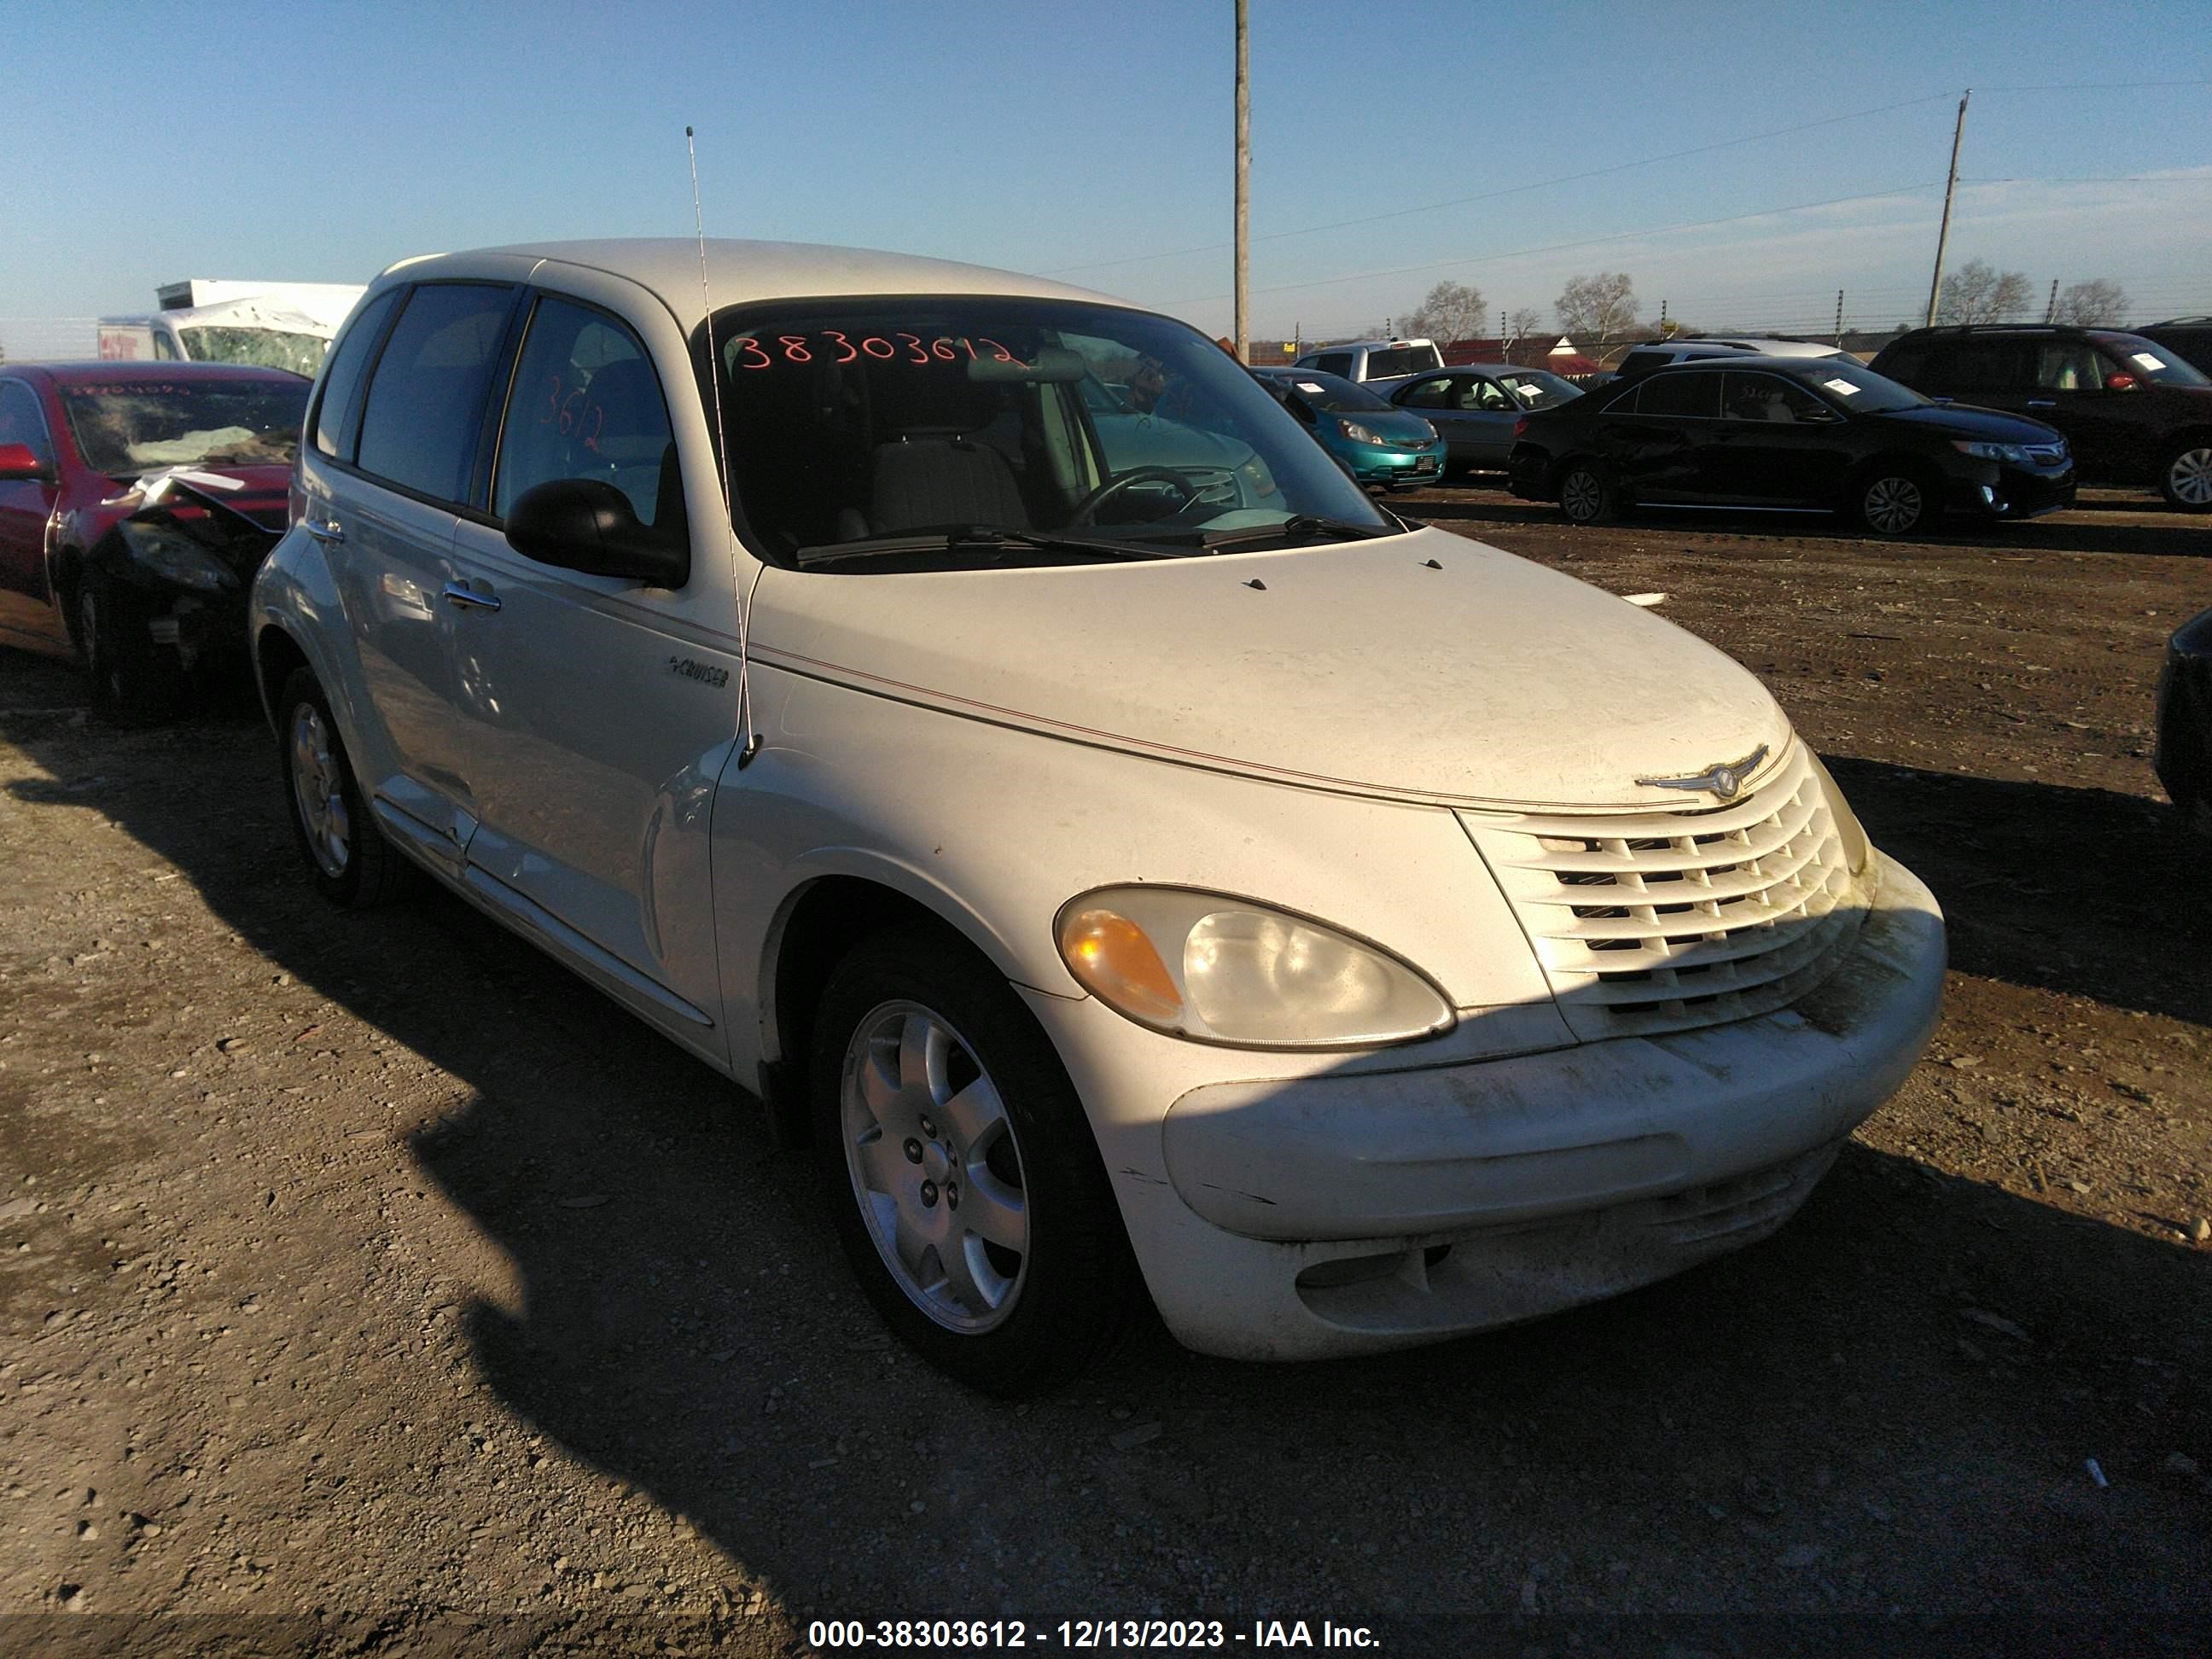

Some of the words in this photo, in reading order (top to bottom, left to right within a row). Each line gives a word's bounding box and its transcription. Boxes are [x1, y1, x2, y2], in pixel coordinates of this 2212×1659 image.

[736, 330, 1031, 370] 38303612
[539, 375, 603, 453] 3612
[679, 658, 730, 689] CRUISER
